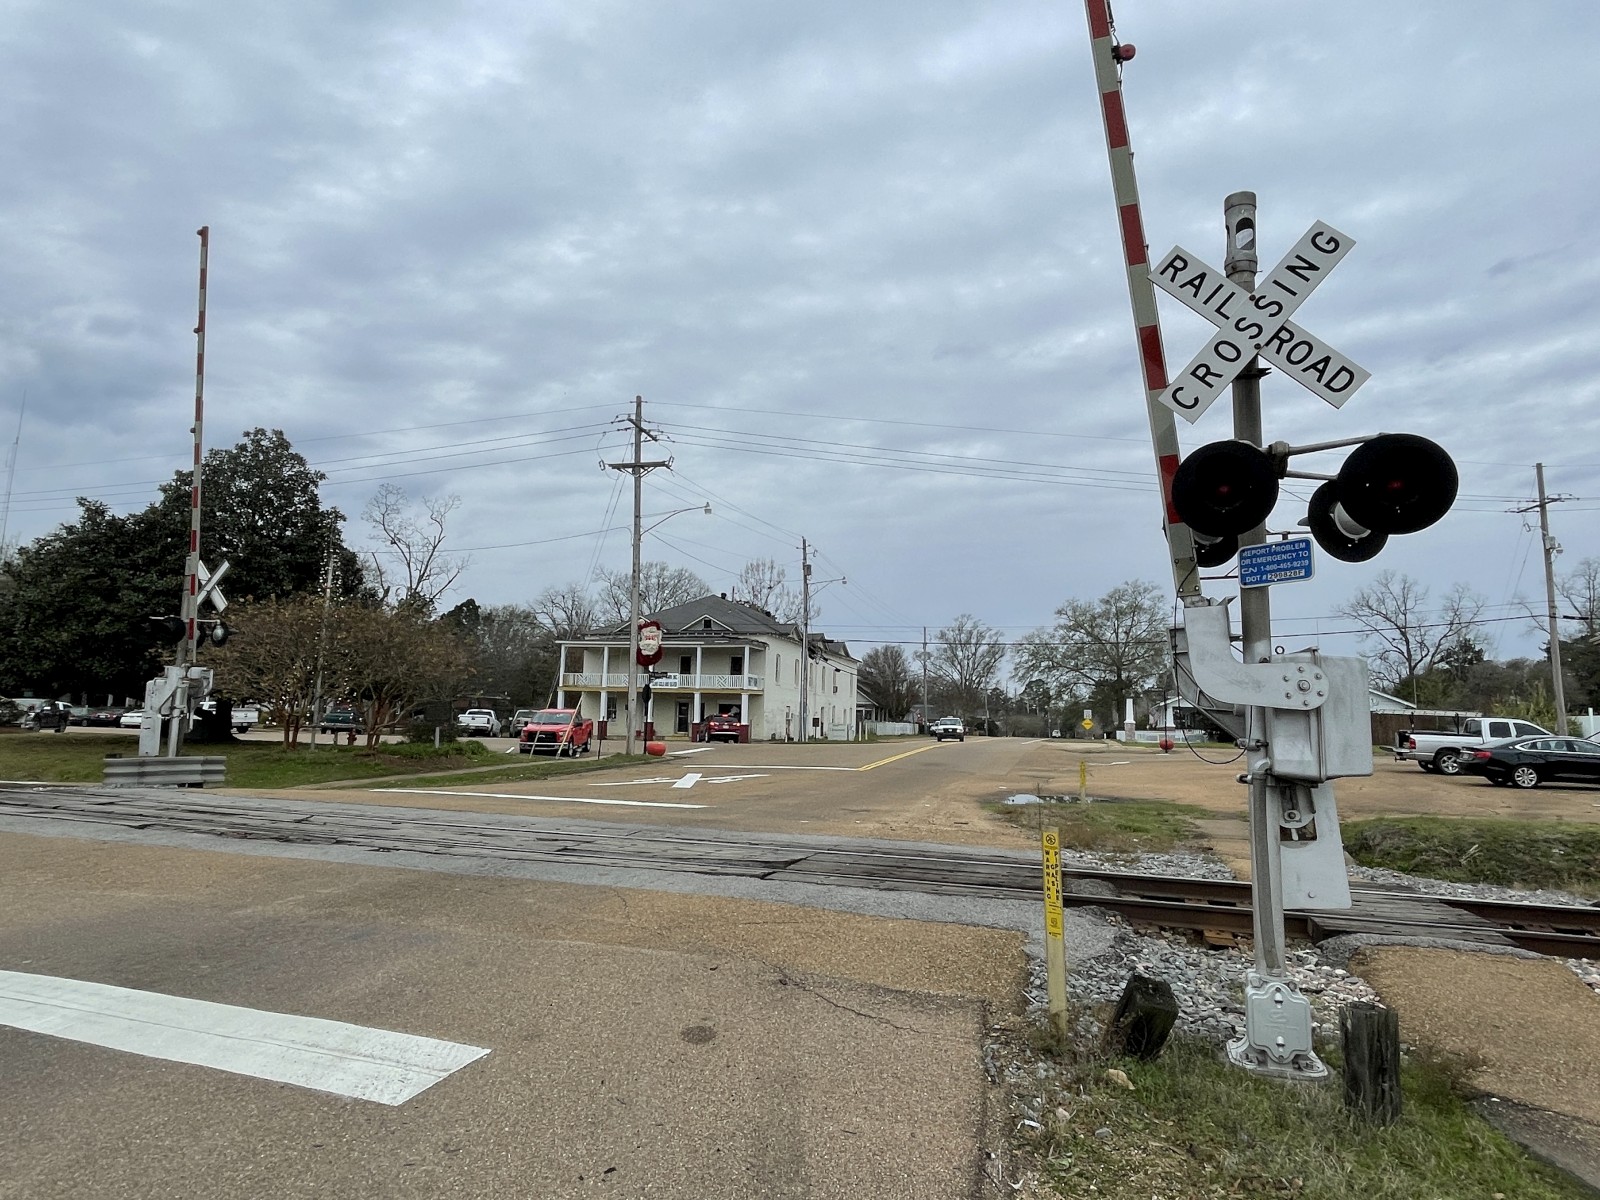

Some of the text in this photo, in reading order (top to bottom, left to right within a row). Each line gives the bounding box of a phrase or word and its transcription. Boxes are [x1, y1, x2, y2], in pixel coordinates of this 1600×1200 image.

[1159, 254, 1355, 393] RAIL ROAD
[1171, 231, 1340, 410] CROSSING
[1242, 542, 1306, 557] REPORT PROBLEM
[1252, 552, 1297, 564] EMERGENCY
[1246, 575, 1262, 583] DOT
